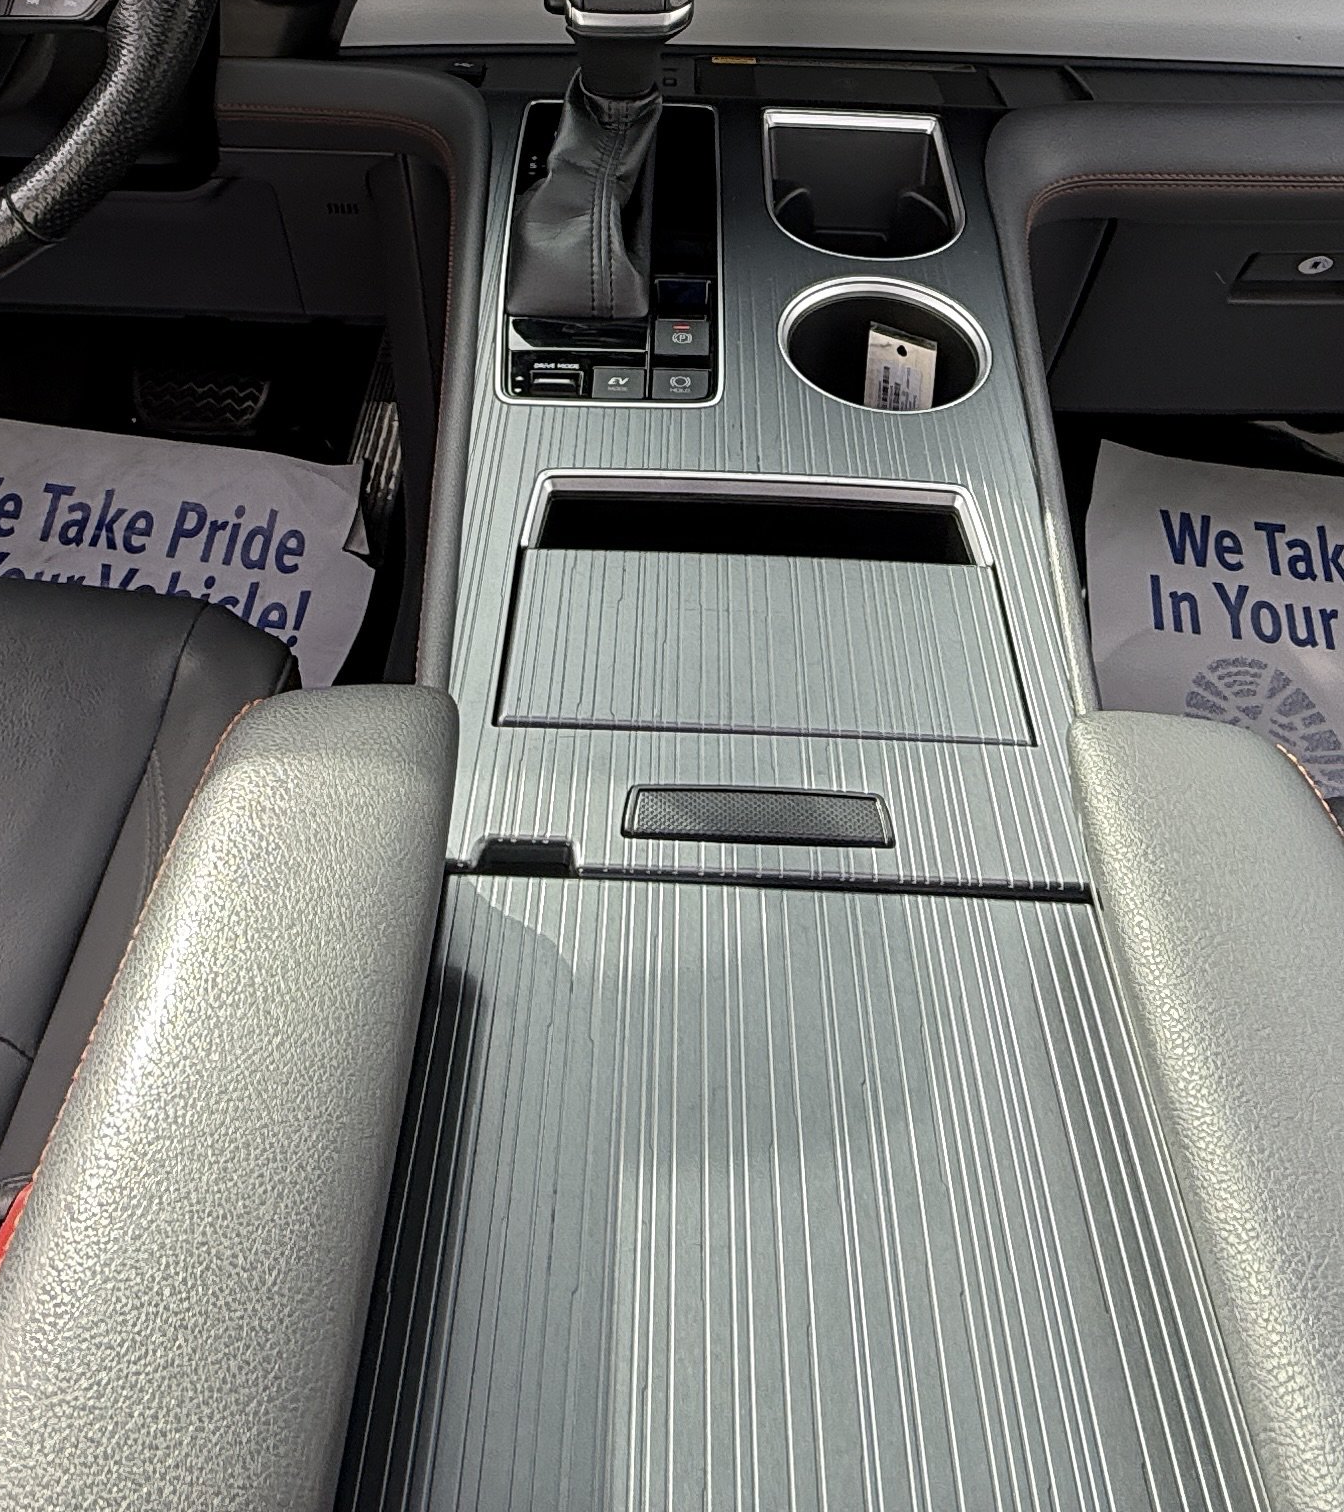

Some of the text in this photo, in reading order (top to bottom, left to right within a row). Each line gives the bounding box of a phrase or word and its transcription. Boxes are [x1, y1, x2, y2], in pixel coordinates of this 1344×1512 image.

[607, 376, 630, 385] EV
[38, 483, 154, 555] Take
[166, 501, 306, 574] Pride
[1159, 509, 1244, 572] We
[1150, 575, 1202, 635] In
[1213, 582, 1340, 650] Your
